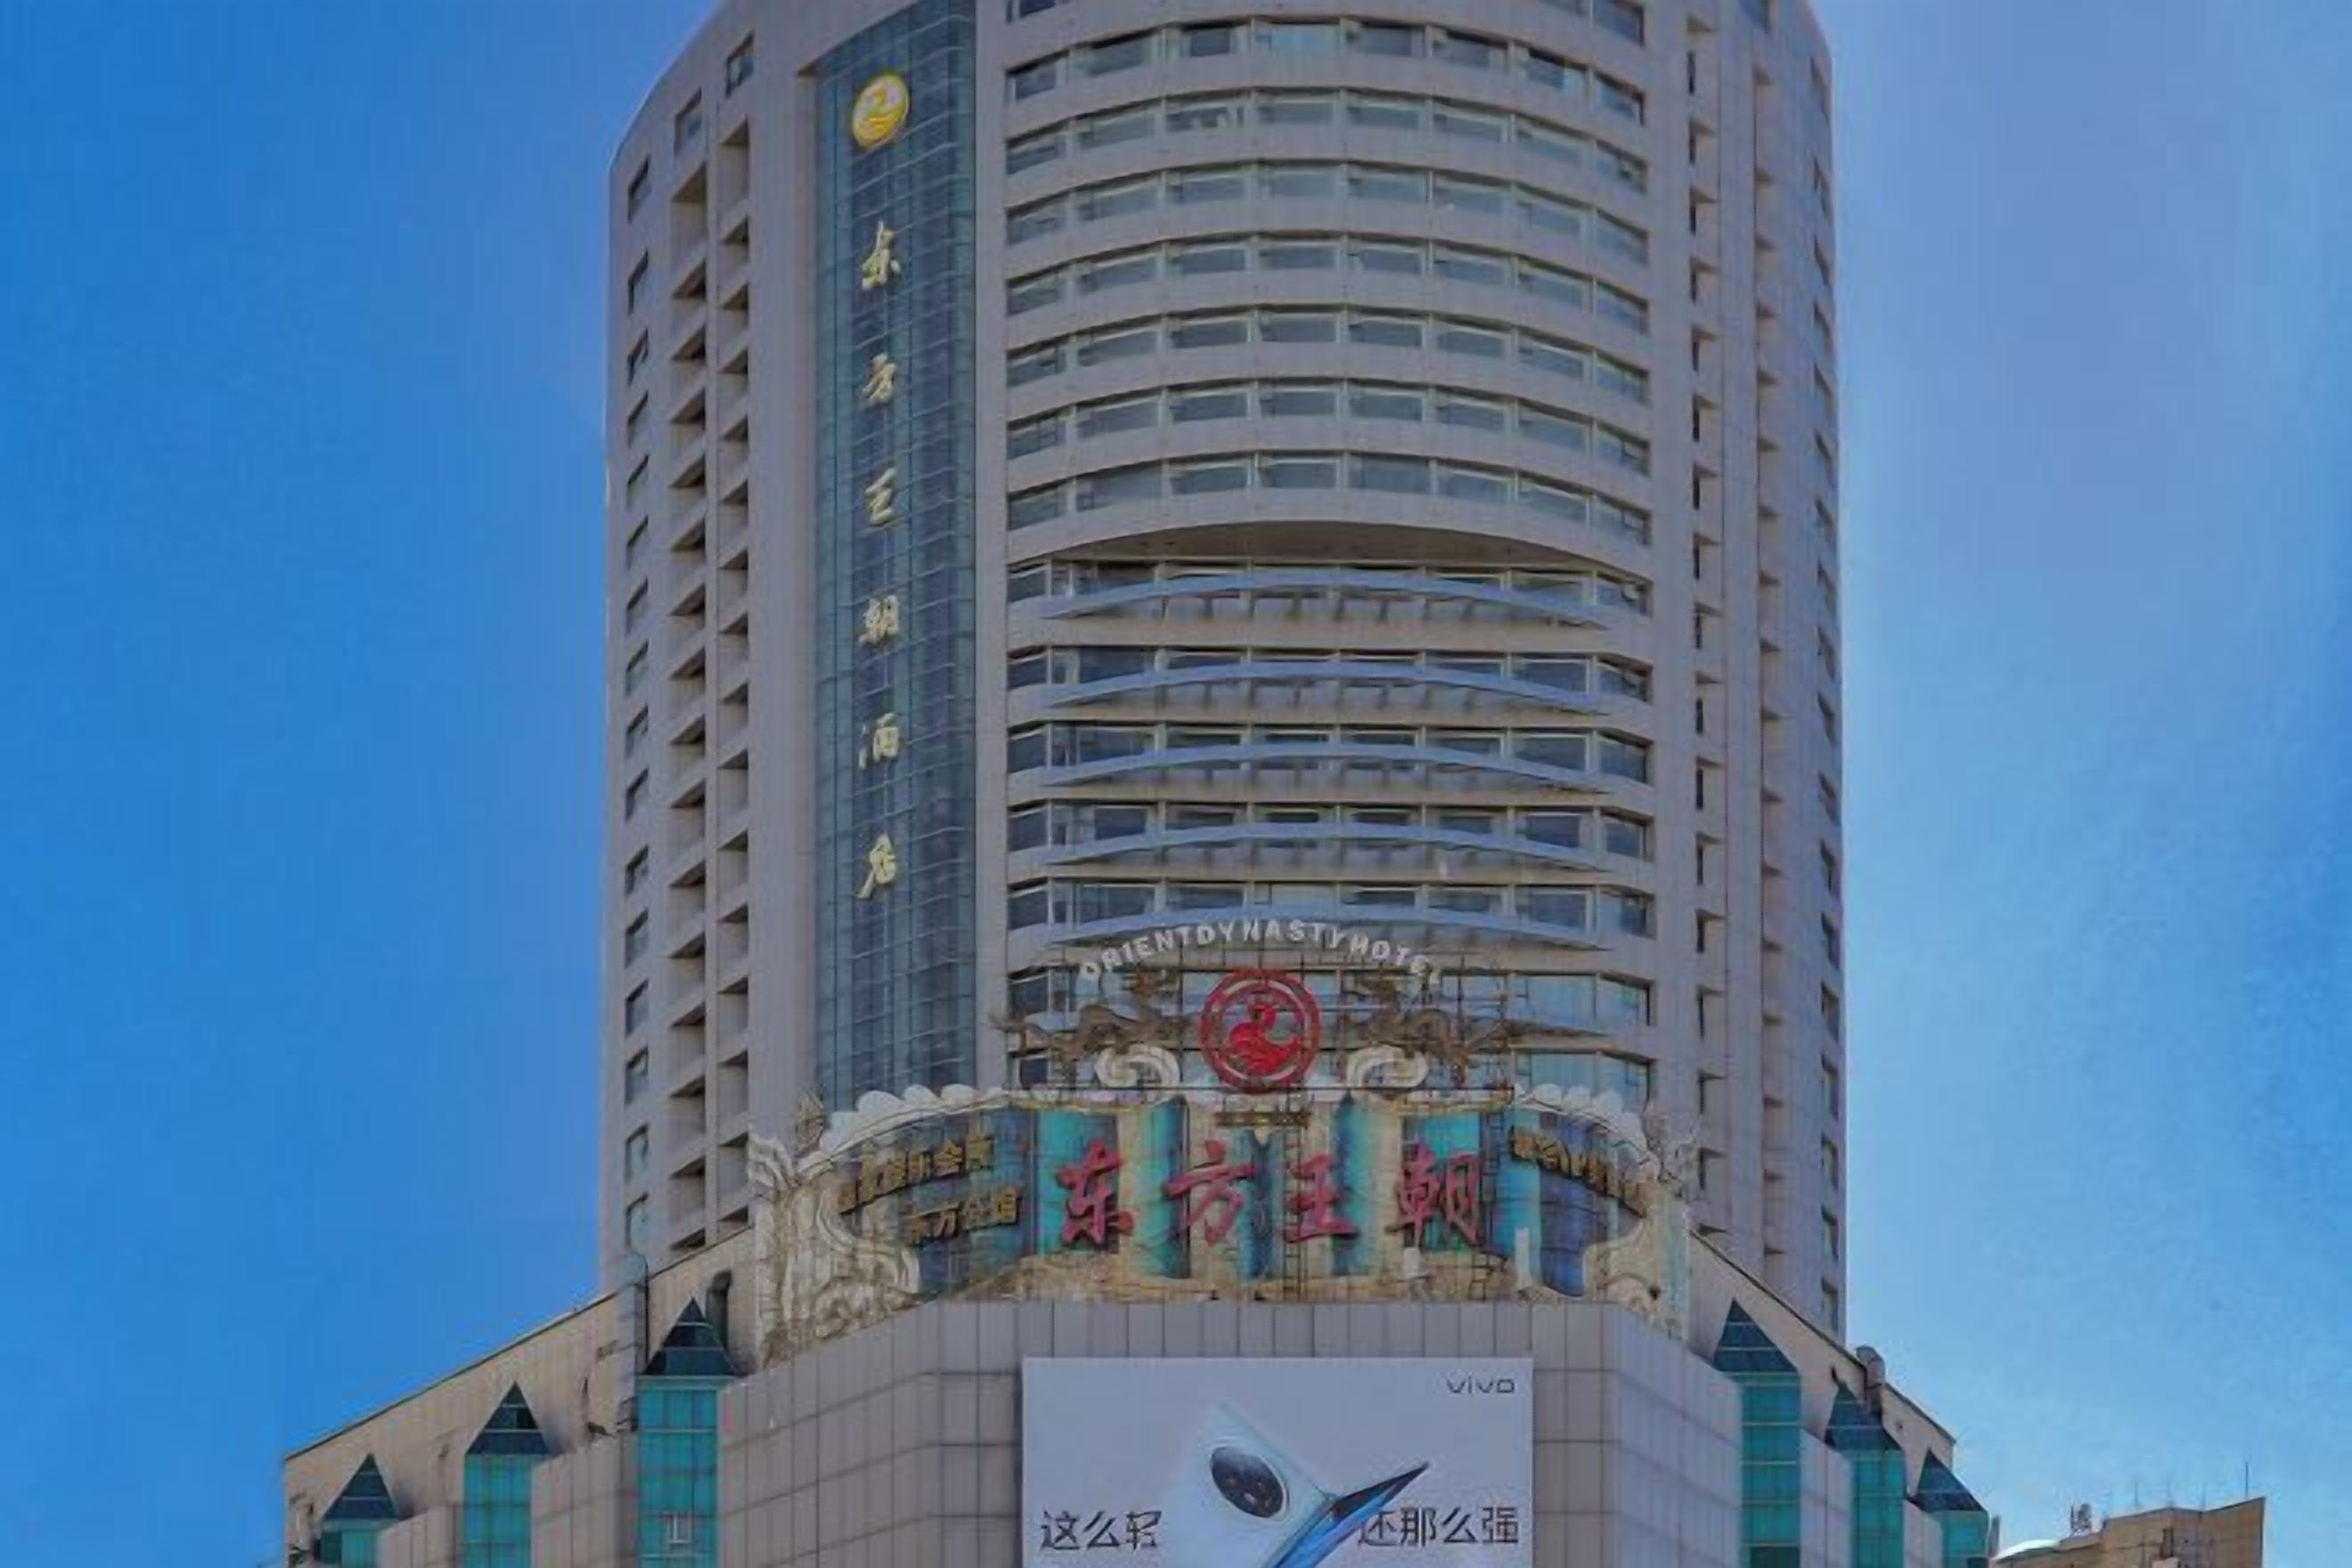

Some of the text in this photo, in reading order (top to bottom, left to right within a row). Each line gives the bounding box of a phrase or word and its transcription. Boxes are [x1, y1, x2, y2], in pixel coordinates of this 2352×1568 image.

[1056, 1139, 1480, 1245] 东方王朝
[1446, 1375, 1515, 1393] vivo
[1041, 1509, 1161, 1550] 这么轻
[1360, 1507, 1519, 1547] 还那么强
